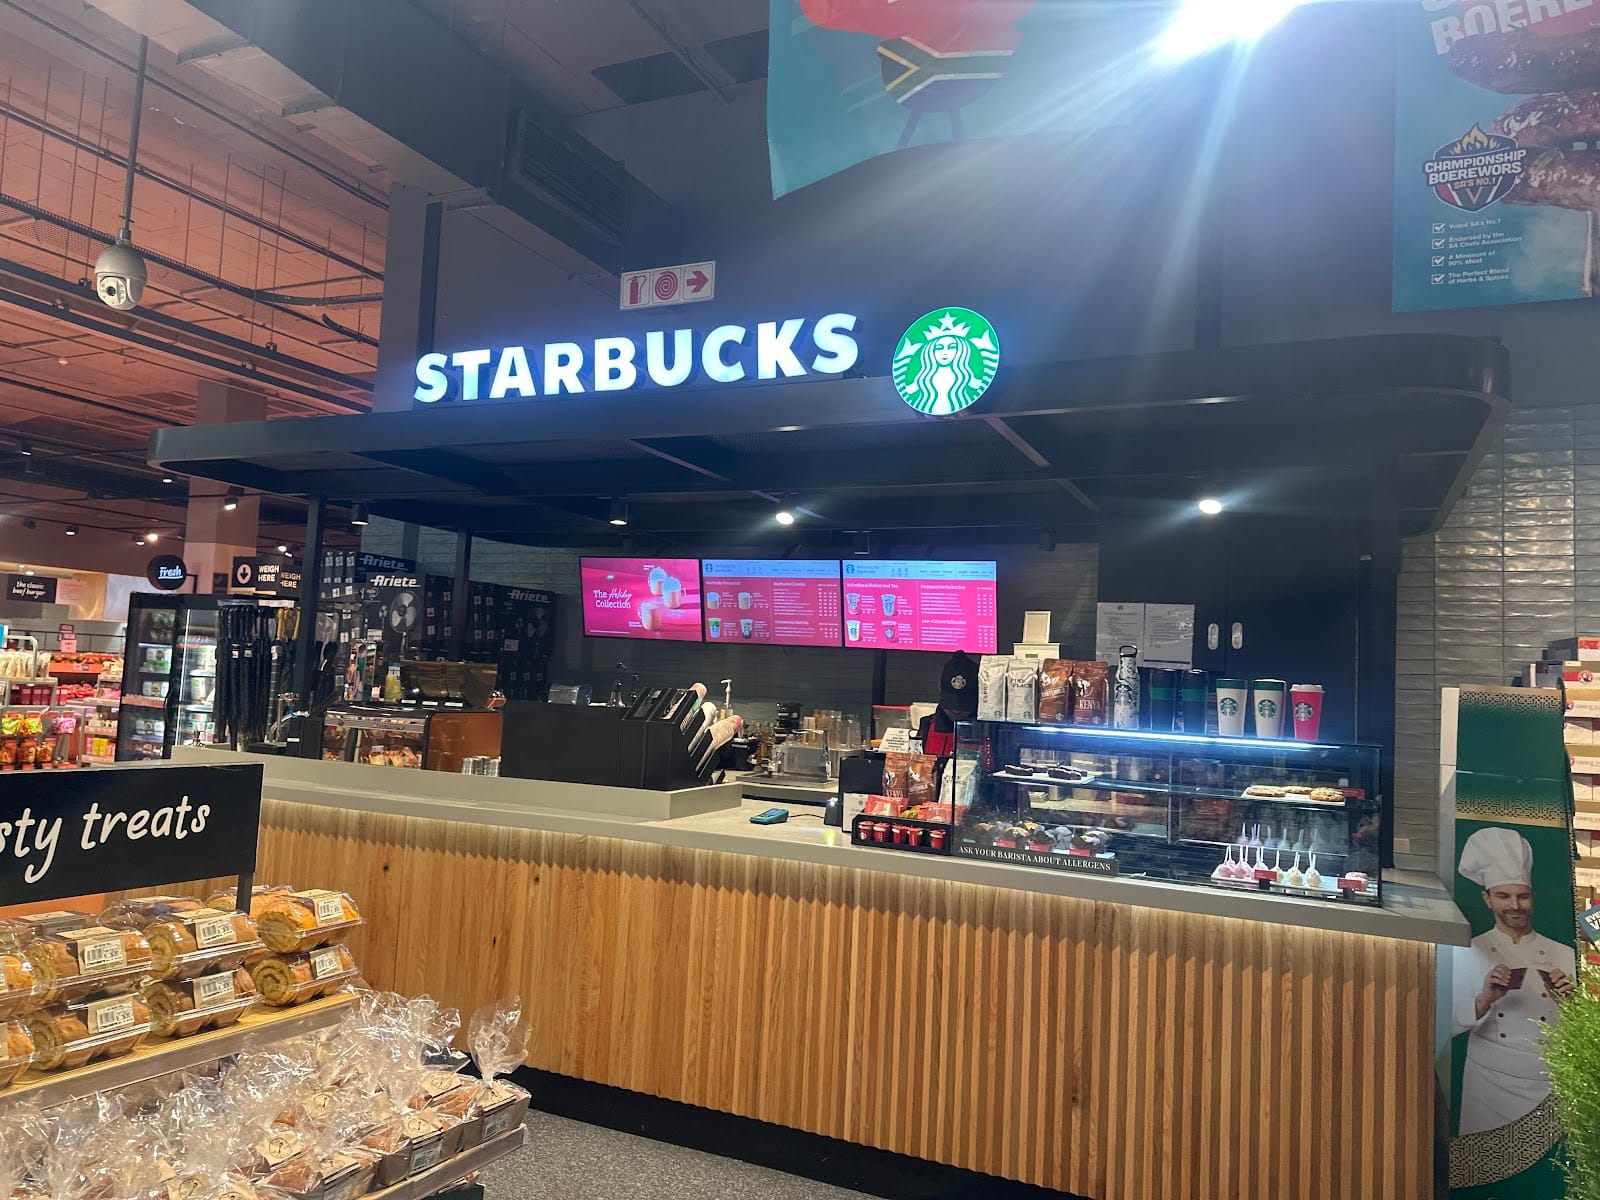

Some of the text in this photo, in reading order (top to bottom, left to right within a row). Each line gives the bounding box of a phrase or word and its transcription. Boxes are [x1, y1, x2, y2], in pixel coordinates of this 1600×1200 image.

[1425, 149, 1527, 173] CHAMPIONSHIP
[1428, 162, 1522, 185] BOEREWORS
[1449, 221, 1469, 230] Voted
[1448, 234, 1481, 243] Endorsed
[1481, 236, 1522, 246] Association
[1455, 252, 1487, 260] Minimum
[1465, 257, 1483, 265] Meat
[1462, 269, 1488, 278] Perfect
[1489, 266, 1510, 275] Blend
[1456, 276, 1477, 284] Herbs
[414, 312, 859, 404] STARBUCKS
[360, 554, 409, 572] Ariete
[159, 564, 182, 577] Fresh
[258, 565, 280, 574] WEIGH
[257, 573, 276, 582] HERE
[370, 574, 421, 588] Ariete
[507, 588, 551, 603] Ariete
[593, 589, 608, 598] The
[595, 599, 631, 609] Collection
[1079, 699, 1101, 710] KENYA
[80, 795, 211, 850] treats
[958, 846, 1111, 871] ASK YOUR BARISTA ABOUT ALLERGENS
